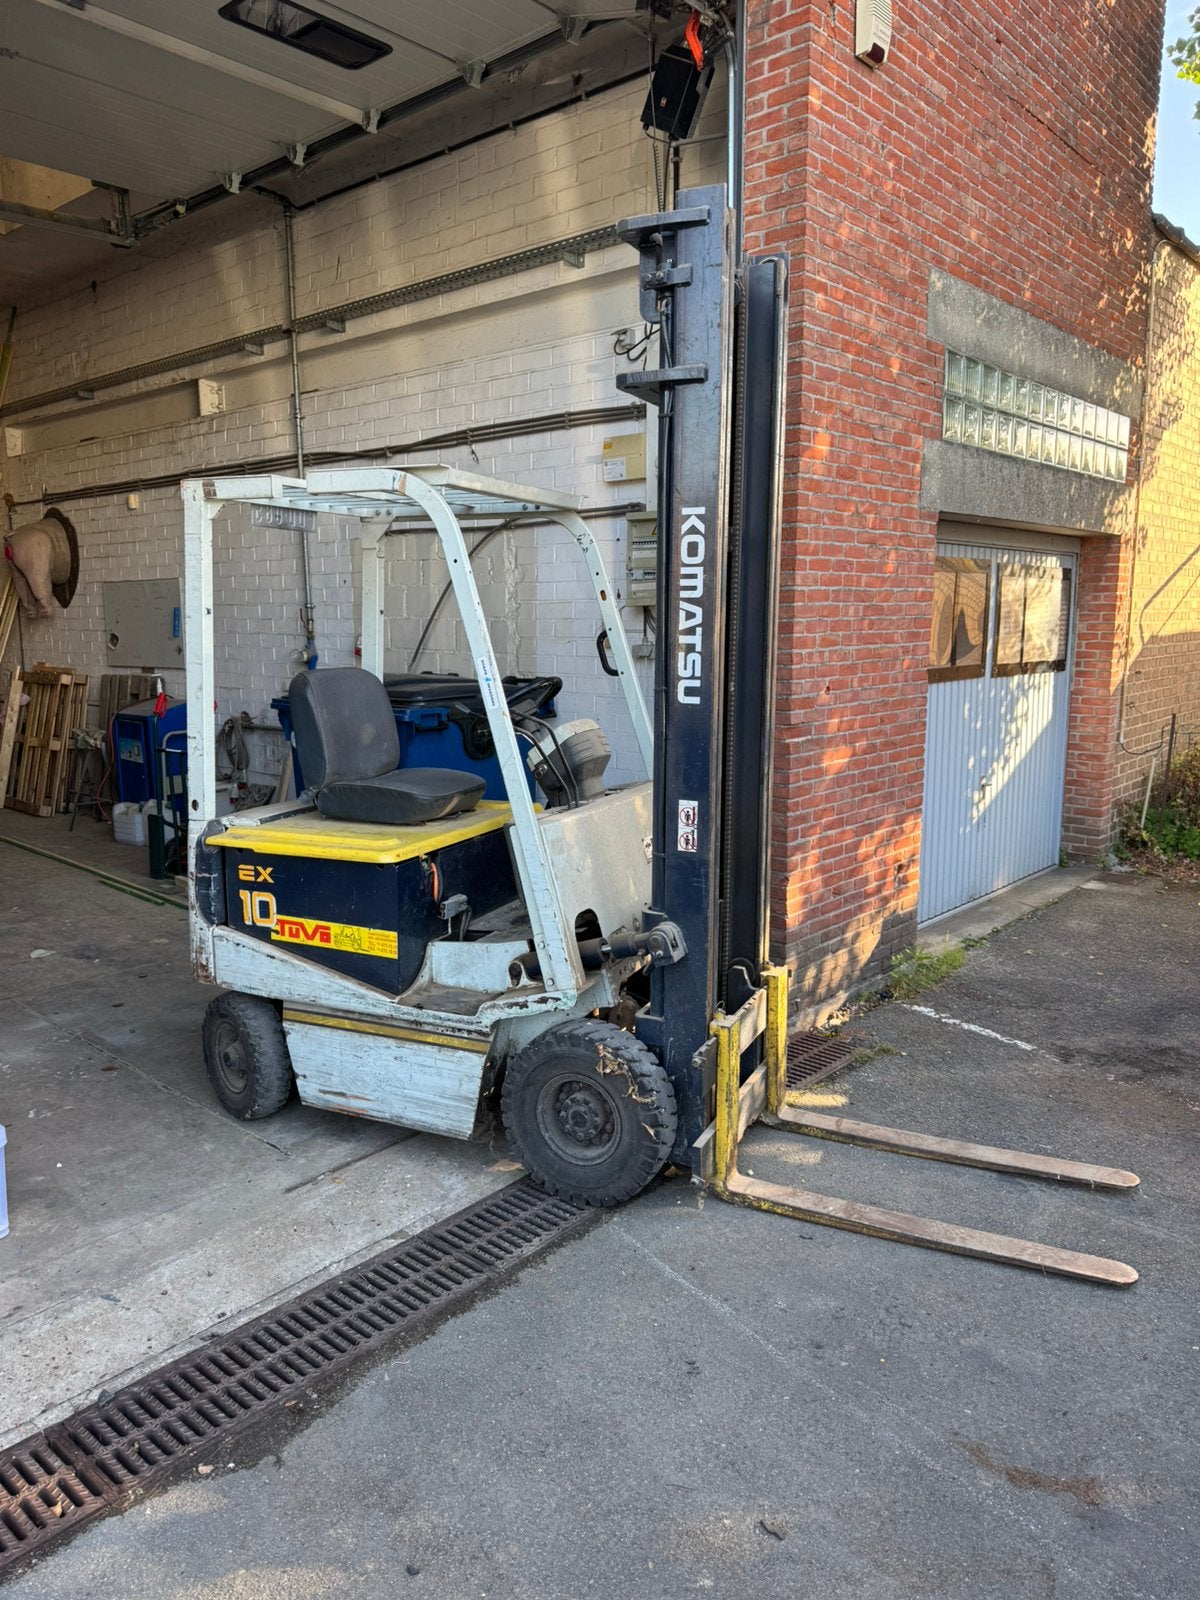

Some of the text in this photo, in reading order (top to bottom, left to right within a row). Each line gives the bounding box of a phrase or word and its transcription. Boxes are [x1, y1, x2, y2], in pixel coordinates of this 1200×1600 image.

[678, 506, 706, 705] KOMATSU
[238, 864, 274, 884] EX
[239, 889, 277, 928] 10
